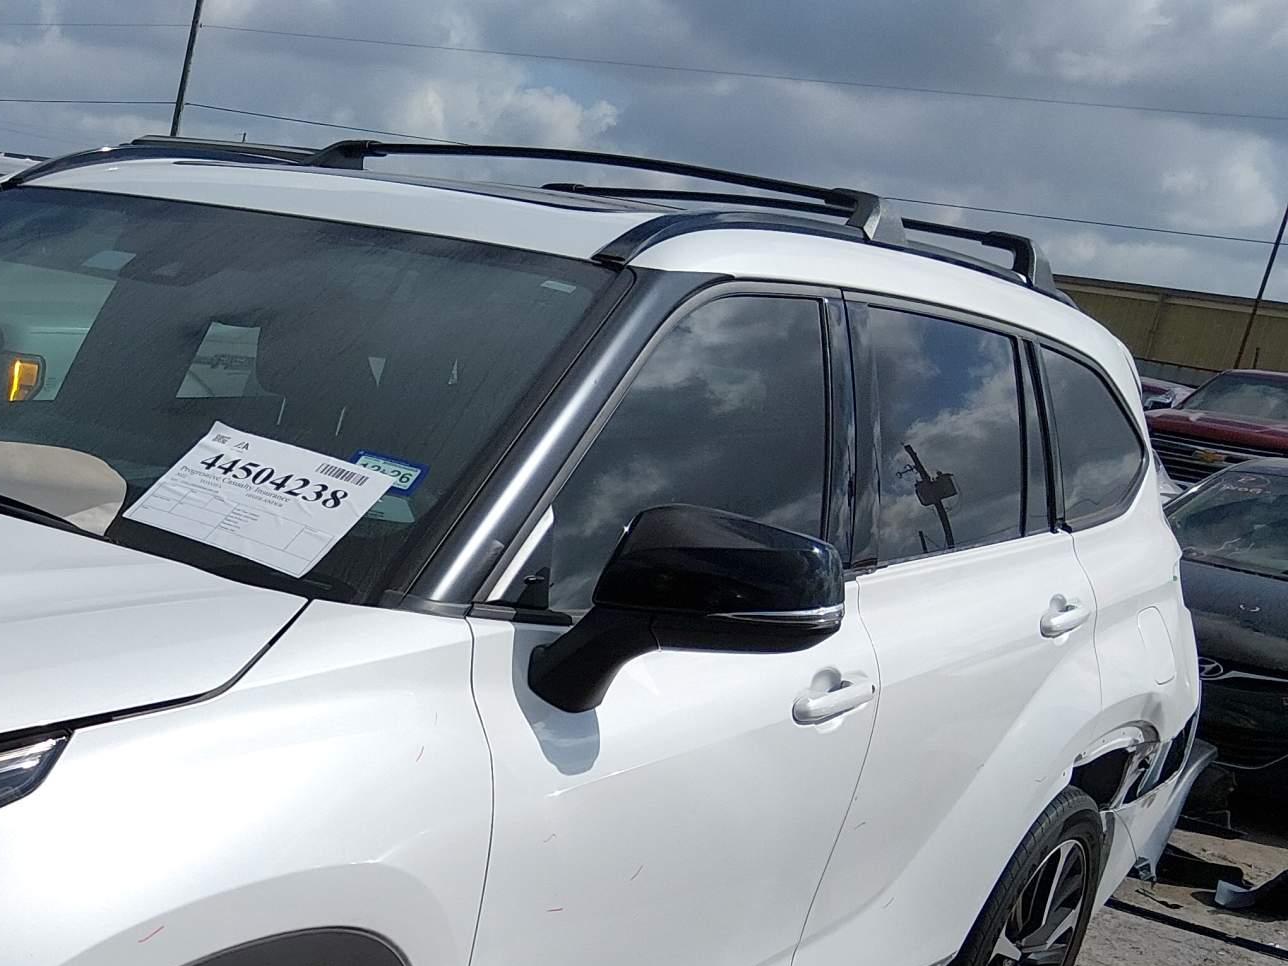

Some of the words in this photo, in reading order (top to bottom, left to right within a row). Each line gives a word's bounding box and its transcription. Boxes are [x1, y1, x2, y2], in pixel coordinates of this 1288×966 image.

[200, 453, 349, 509] 44504238
[222, 477, 252, 491] Casualty
[254, 487, 291, 502] Insurance
